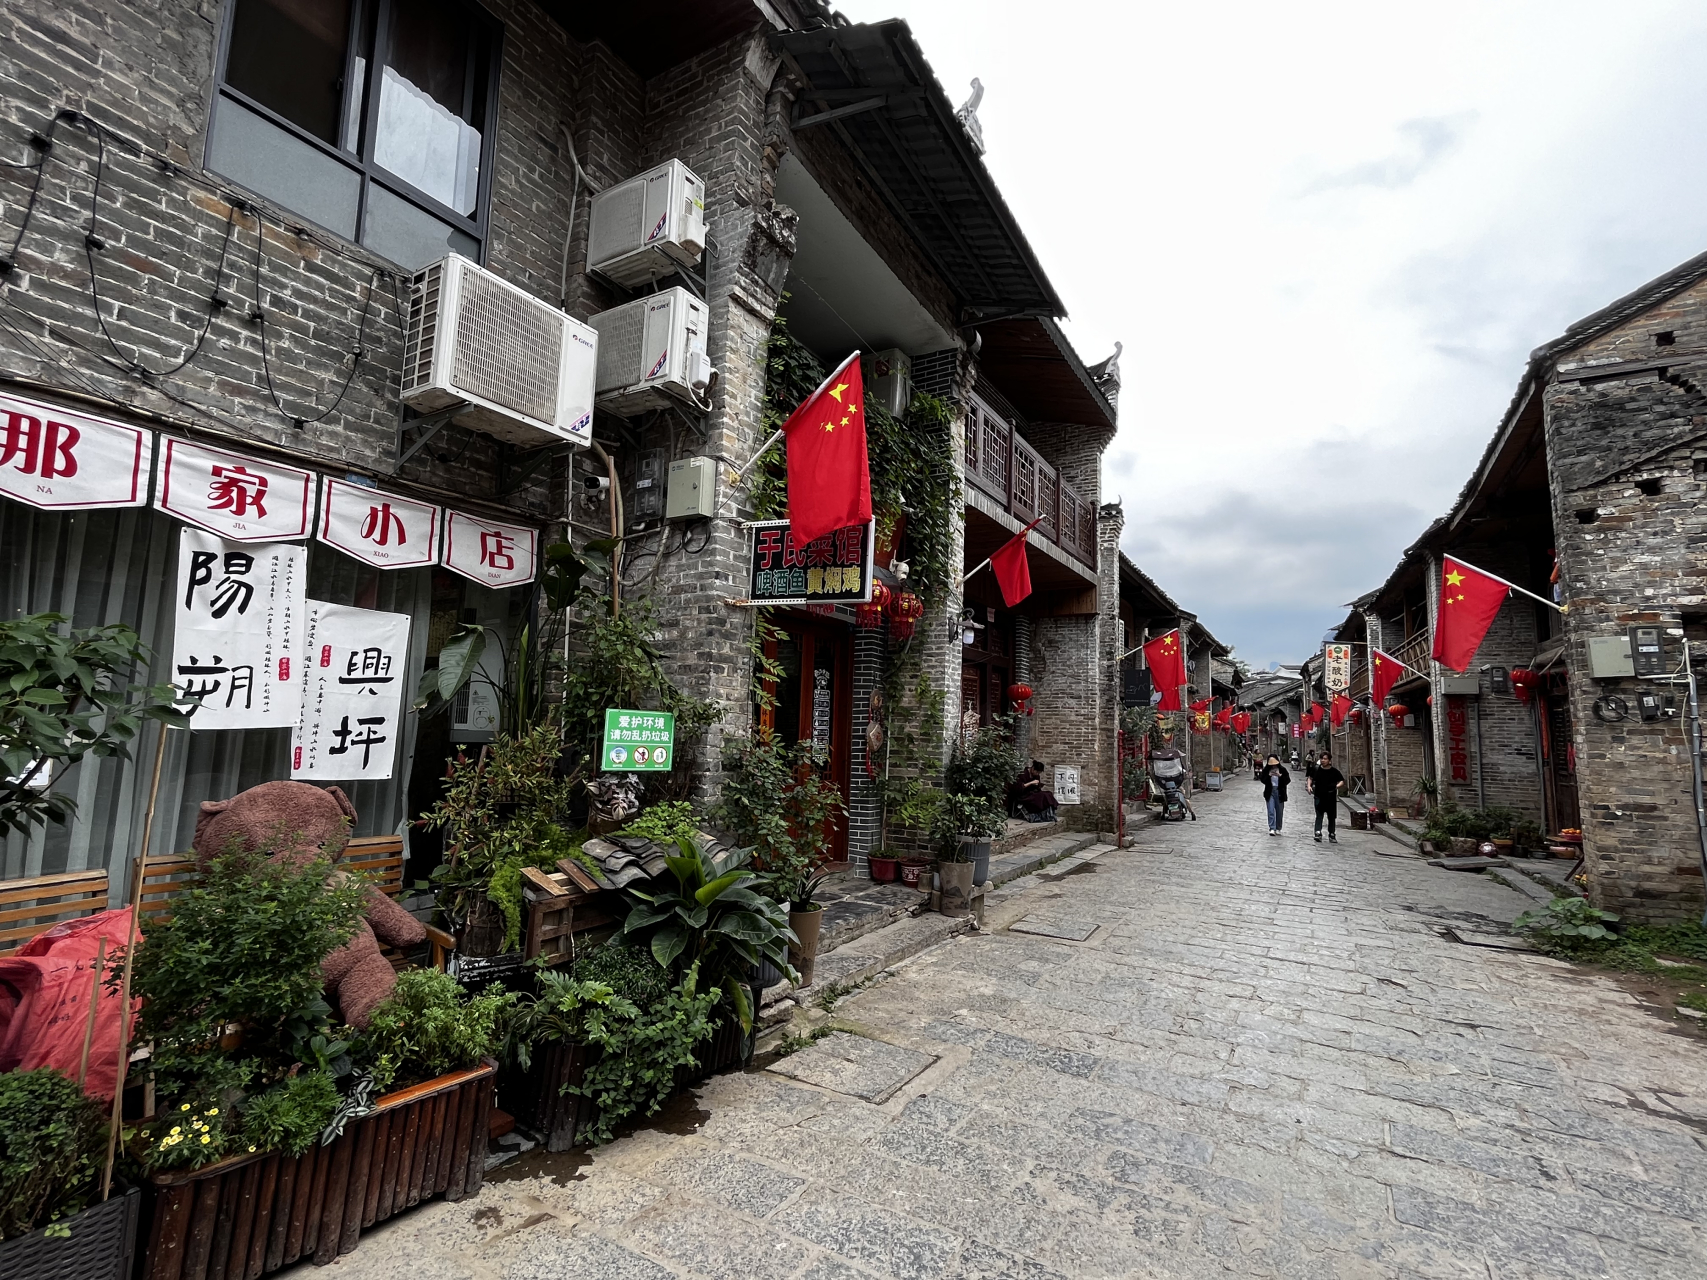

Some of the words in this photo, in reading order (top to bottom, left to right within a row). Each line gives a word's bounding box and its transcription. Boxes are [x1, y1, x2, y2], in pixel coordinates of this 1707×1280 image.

[0, 409, 80, 479] 那
[207, 465, 268, 519] 家
[360, 503, 407, 547] 小
[480, 530, 515, 571] 店
[36, 485, 53, 495] NA
[232, 522, 247, 531] JIA
[372, 550, 389, 559] XIAO
[1331, 655, 1344, 688] 老酸奶
[610, 729, 670, 741] 请勿乱扔垃圾
[618, 715, 665, 729] 爱护环境
